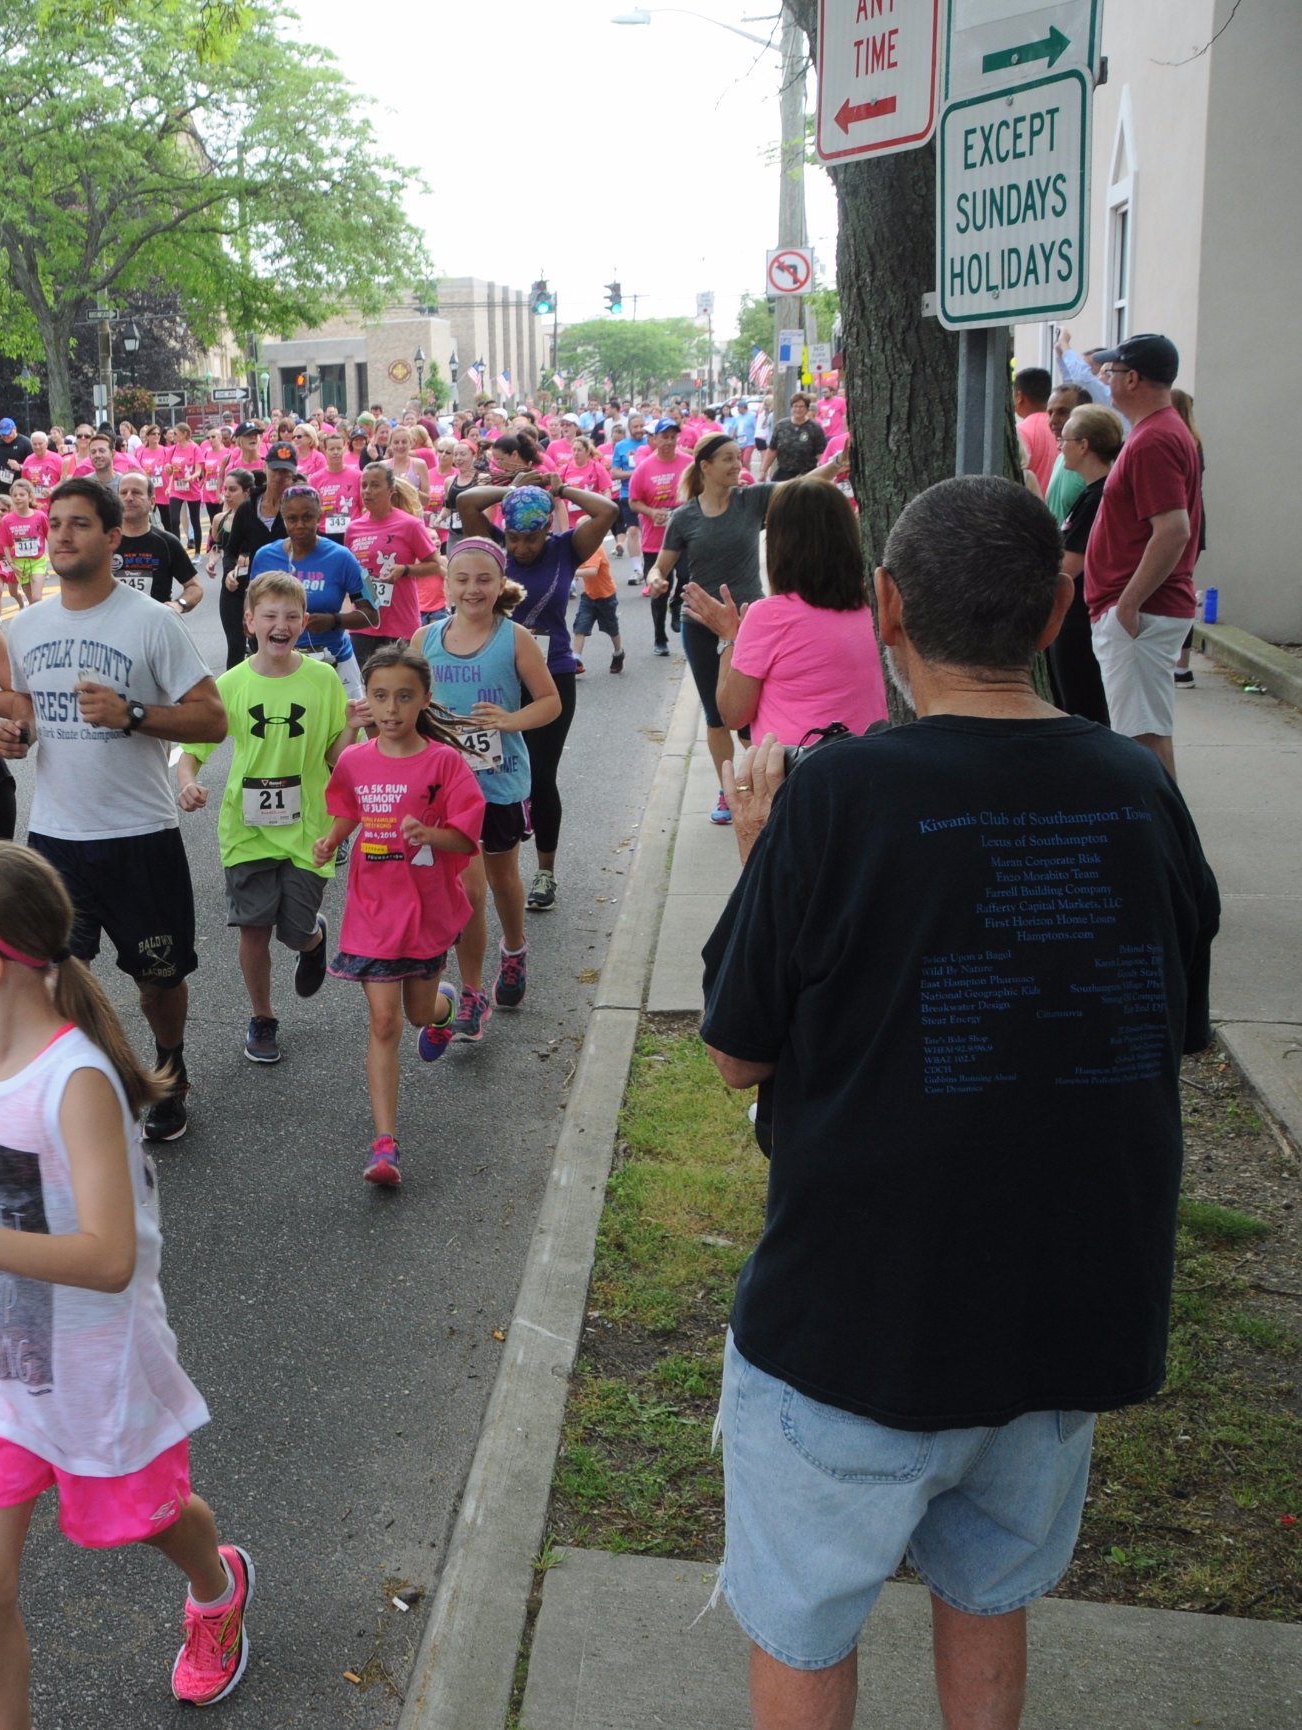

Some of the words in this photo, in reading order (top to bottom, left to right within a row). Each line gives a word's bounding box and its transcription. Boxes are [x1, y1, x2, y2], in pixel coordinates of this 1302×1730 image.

[853, 28, 899, 79] TIME
[964, 106, 1060, 171] EXCEPT
[956, 173, 1067, 234] SUNDAYS
[950, 238, 1073, 297] HOLIDAYS
[124, 557, 160, 566] METS
[307, 571, 324, 580] UP
[303, 579, 325, 591] GO!
[23, 639, 75, 680] SUFFOLK
[79, 639, 133, 688] COUNTY
[433, 664, 482, 683] WATCH
[477, 687, 504, 705] OUT
[371, 784, 384, 794] 5K
[385, 784, 408, 794] RUN
[259, 790, 285, 810] 21
[362, 794, 402, 804] MEMORY
[371, 804, 392, 813] JUDI
[918, 814, 977, 834] Kiwanis
[979, 811, 1009, 826] Club
[1013, 811, 1027, 826] of
[1028, 808, 1119, 828] Southampton
[980, 835, 1011, 848] Lexus
[1014, 835, 1027, 847] of
[1029, 833, 1108, 849] Southampton
[1025, 855, 1075, 869] Corporate
[1077, 853, 1102, 864] Risk
[995, 871, 1020, 882] Enzo
[1023, 870, 1069, 881] Morabito
[1071, 868, 1099, 879] Team
[985, 887, 1018, 898] Farrell
[1021, 885, 1064, 897] Building
[1065, 883, 1112, 896] Company
[975, 902, 1016, 914] Rafferty
[1019, 899, 1055, 912] Capital
[1103, 898, 1123, 908] LLC
[985, 917, 1010, 928] First
[1011, 915, 1053, 927] Horizon
[1055, 914, 1088, 925] Home
[1017, 930, 1094, 943] Hamptons.com
[950, 953, 976, 963] Upon
[985, 950, 1011, 961] Bagel
[921, 979, 940, 989] East
[944, 978, 987, 989] Hampton
[921, 990, 962, 1001] National
[964, 988, 1018, 999] Geographic
[921, 1002, 975, 1013] Breakwater
[977, 1001, 1011, 1011] Design
